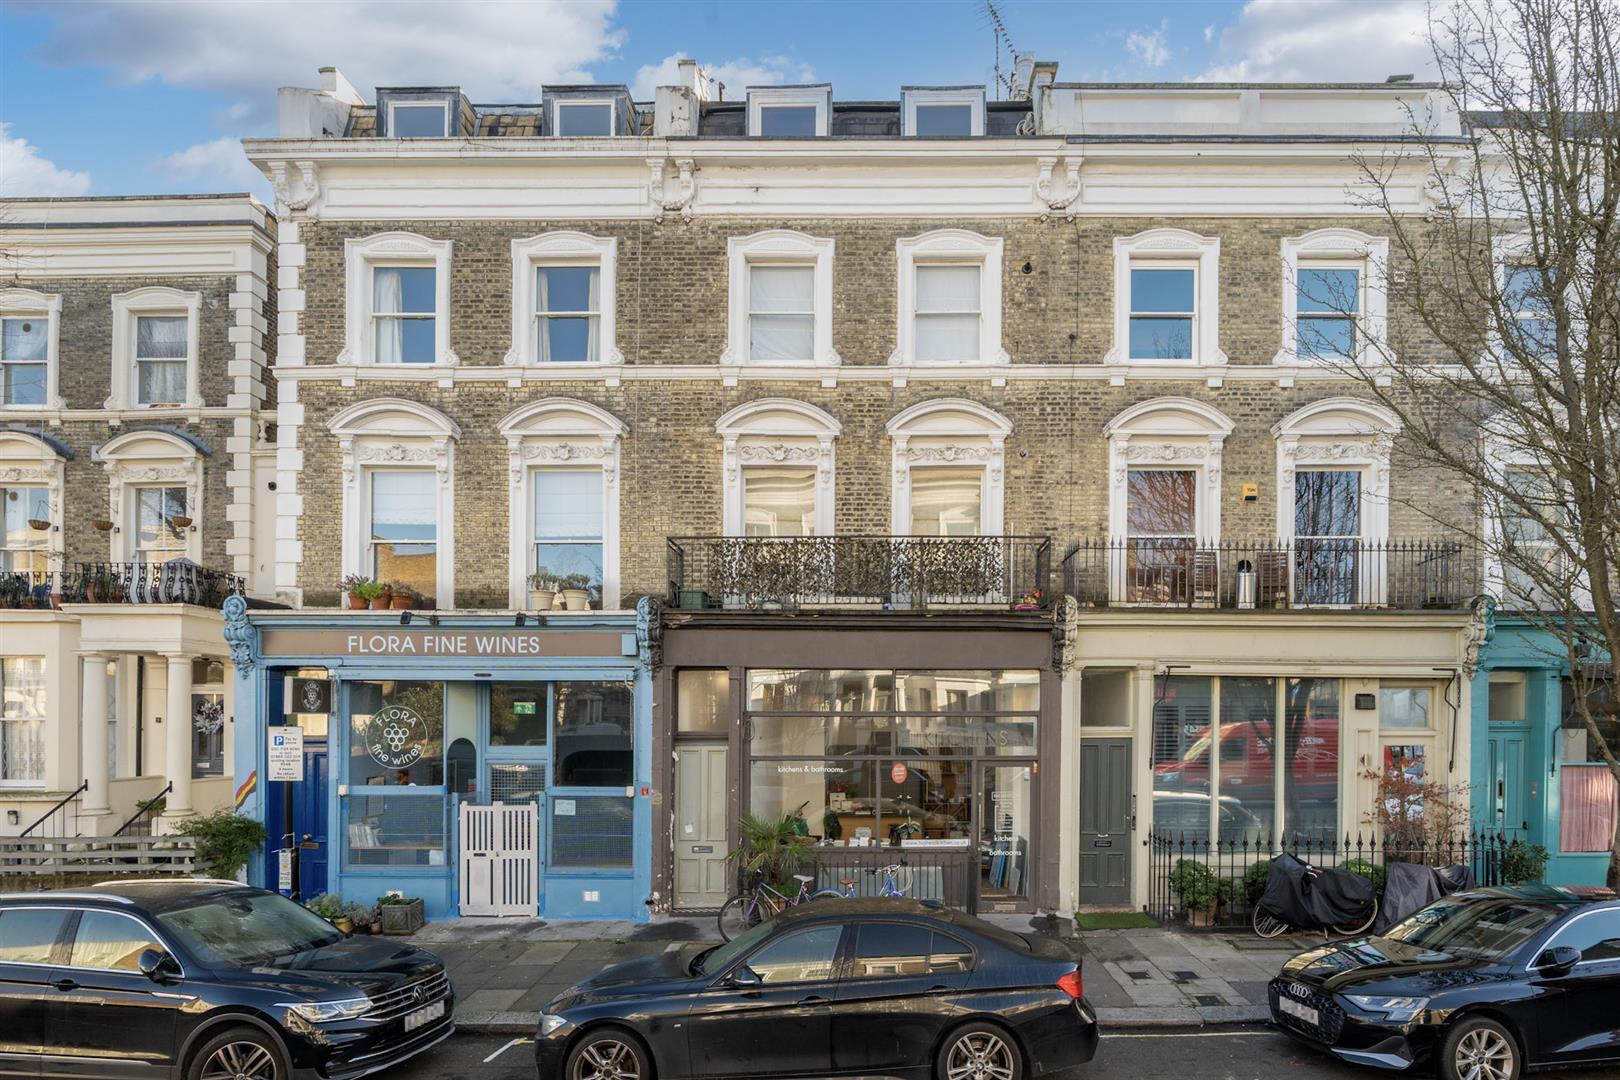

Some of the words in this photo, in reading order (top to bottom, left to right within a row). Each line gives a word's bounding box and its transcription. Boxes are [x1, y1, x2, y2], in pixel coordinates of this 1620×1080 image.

[348, 635, 416, 653] FLORA
[424, 636, 467, 653] FINE
[475, 636, 540, 654] WINES
[375, 709, 416, 728] FLORA
[926, 730, 1009, 746] KINS
[371, 743, 389, 762] fine
[391, 743, 422, 765] wines
[777, 765, 803, 773] kitchens
[804, 765, 809, 773] &
[811, 765, 844, 773] bathrooms
[994, 834, 1018, 842] kitchens
